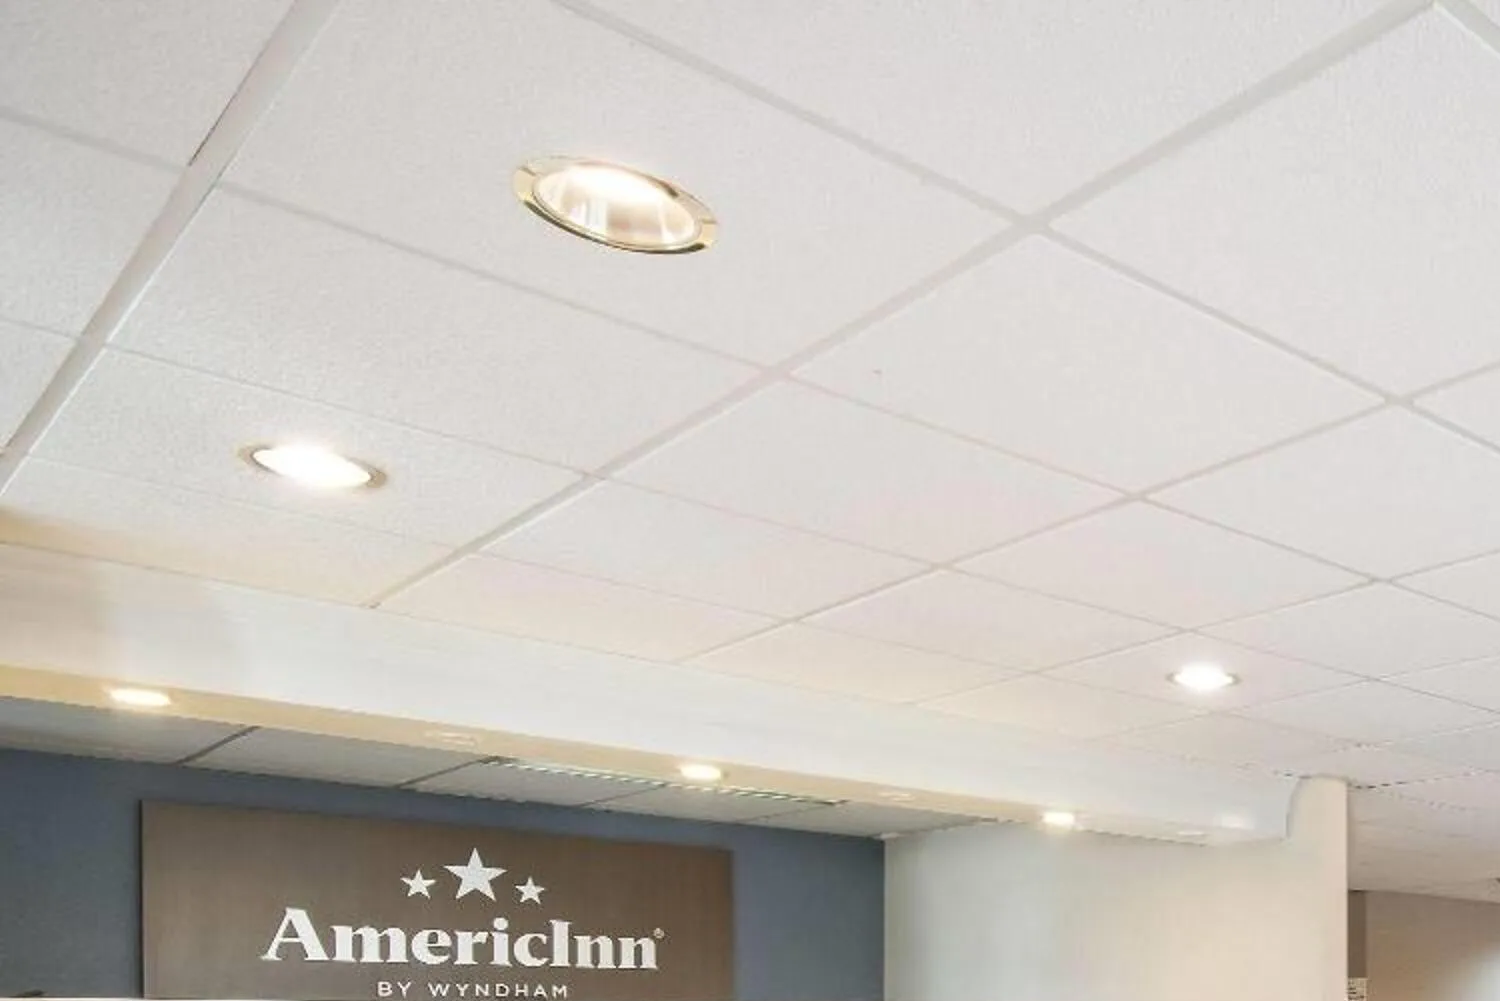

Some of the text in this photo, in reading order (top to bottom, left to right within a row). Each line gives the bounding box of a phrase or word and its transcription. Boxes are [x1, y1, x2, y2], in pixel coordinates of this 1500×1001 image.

[259, 906, 659, 970] AmericInn
[376, 980, 569, 999] BY WYNDHAM
